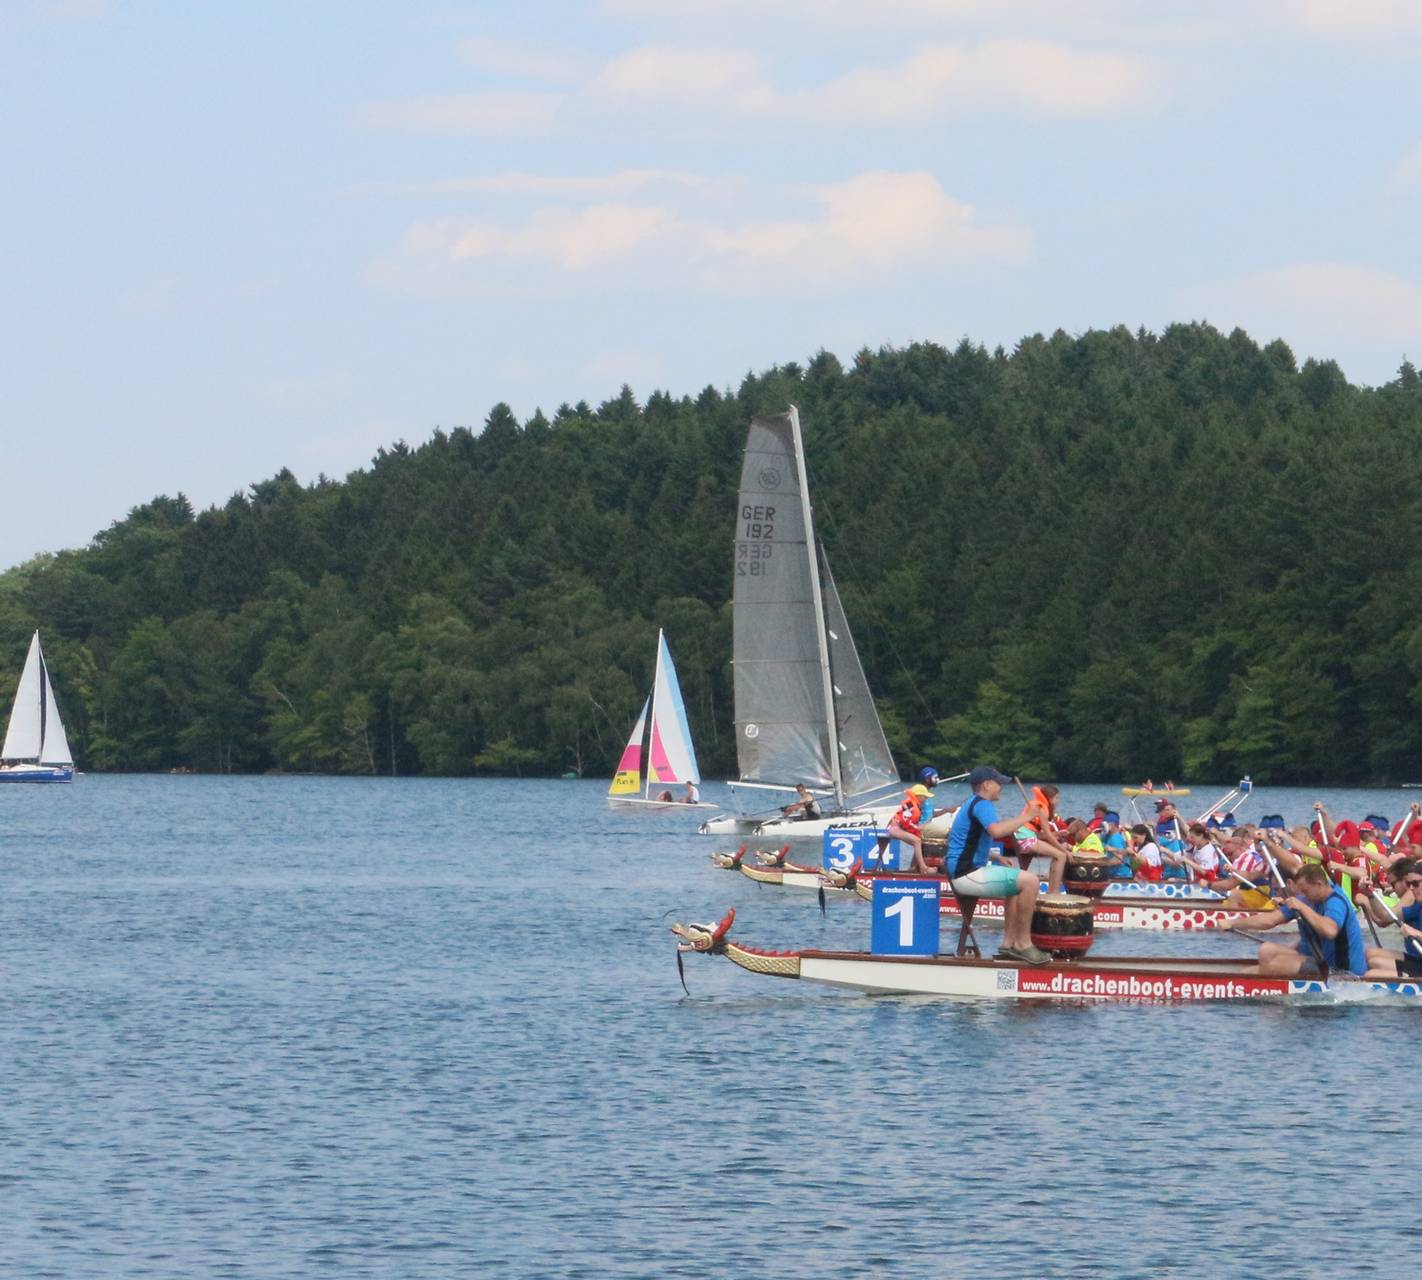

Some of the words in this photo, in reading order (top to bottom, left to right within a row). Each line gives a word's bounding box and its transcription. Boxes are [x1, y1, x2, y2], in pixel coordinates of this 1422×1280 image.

[742, 506, 776, 521] GER
[747, 524, 774, 539] 192
[830, 838, 855, 867] 3
[868, 843, 894, 865] 4
[885, 896, 914, 947] 1
[1022, 973, 1282, 998] www.drachenboot-events.com
